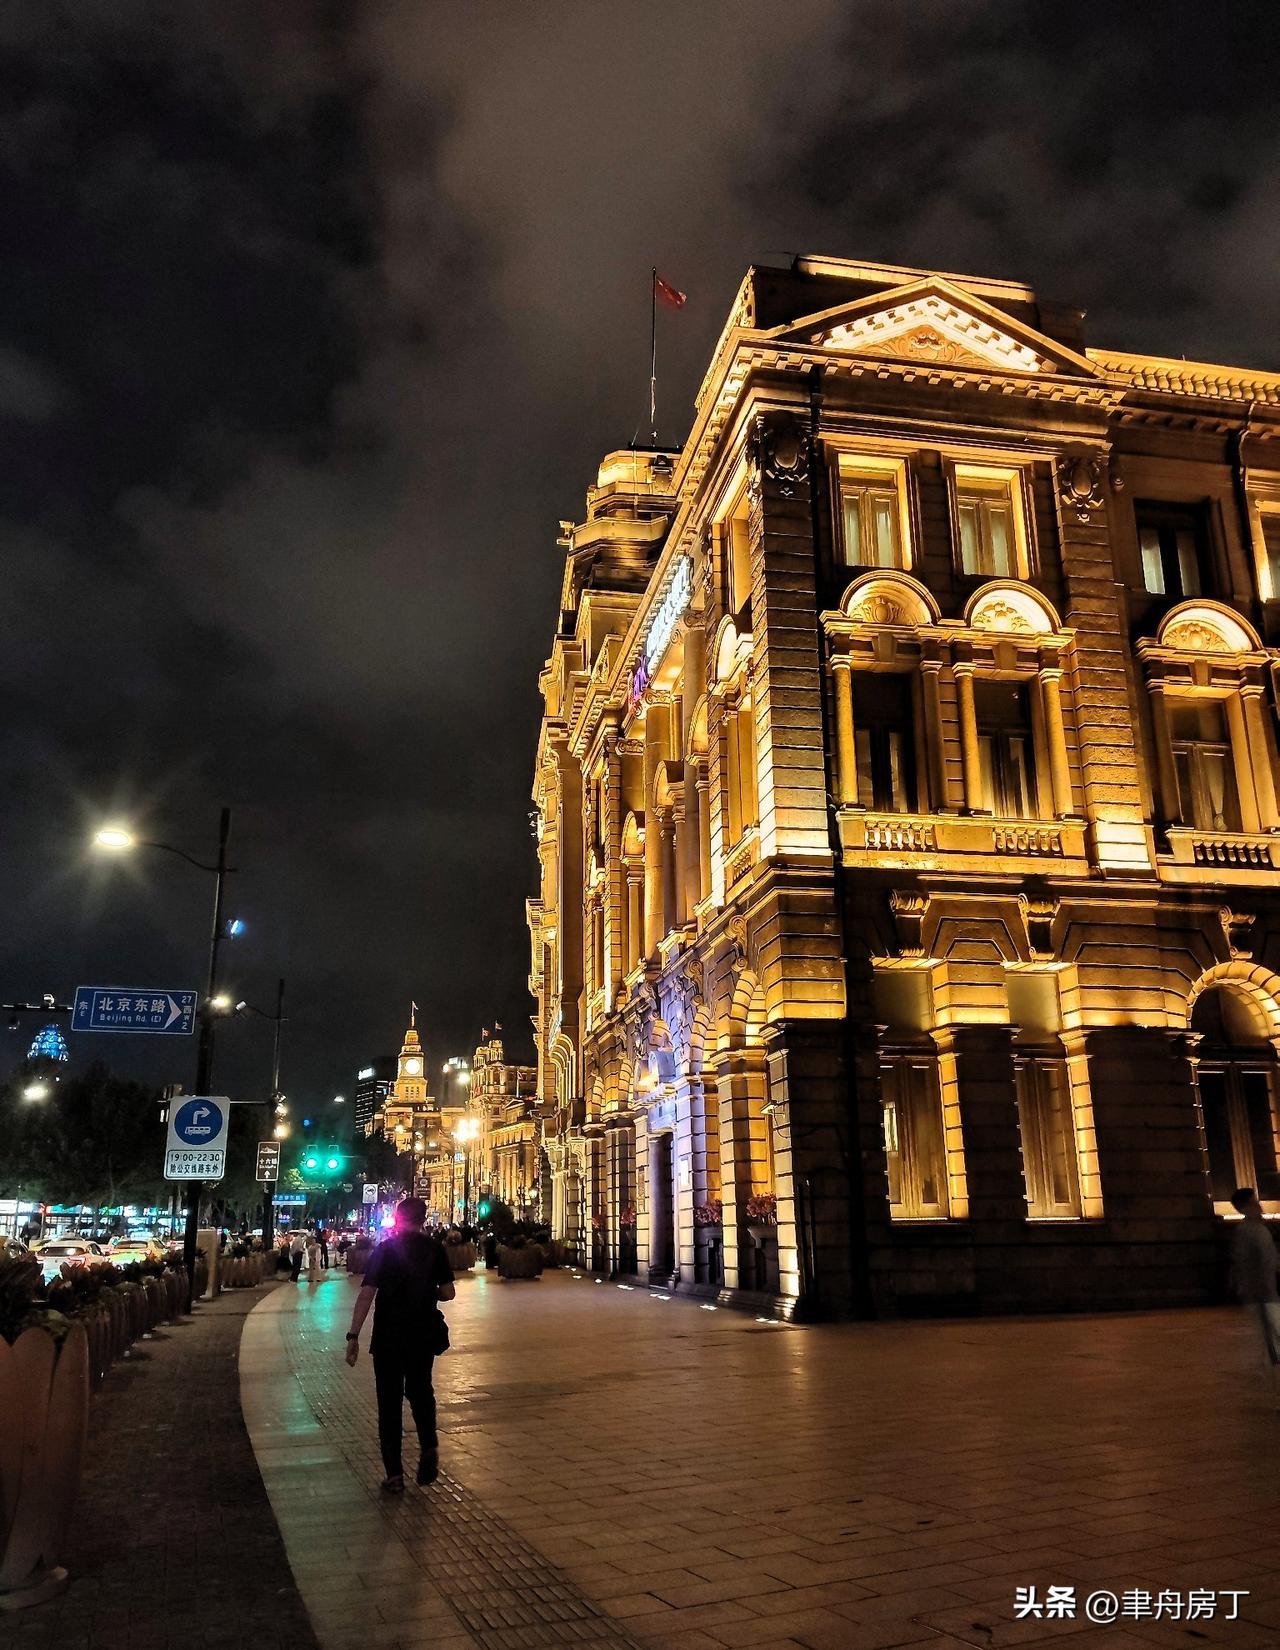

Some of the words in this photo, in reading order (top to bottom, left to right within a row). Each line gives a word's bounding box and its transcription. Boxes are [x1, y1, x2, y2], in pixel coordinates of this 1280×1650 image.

[181, 995, 192, 1004] 27
[78, 1001, 88, 1010] 东
[98, 997, 166, 1014] 北京东路
[182, 1005, 192, 1014] 西
[99, 1013, 132, 1023] Beijing
[181, 1022, 187, 1030] 2
[169, 1163, 219, 1174] 除公交线路车外
